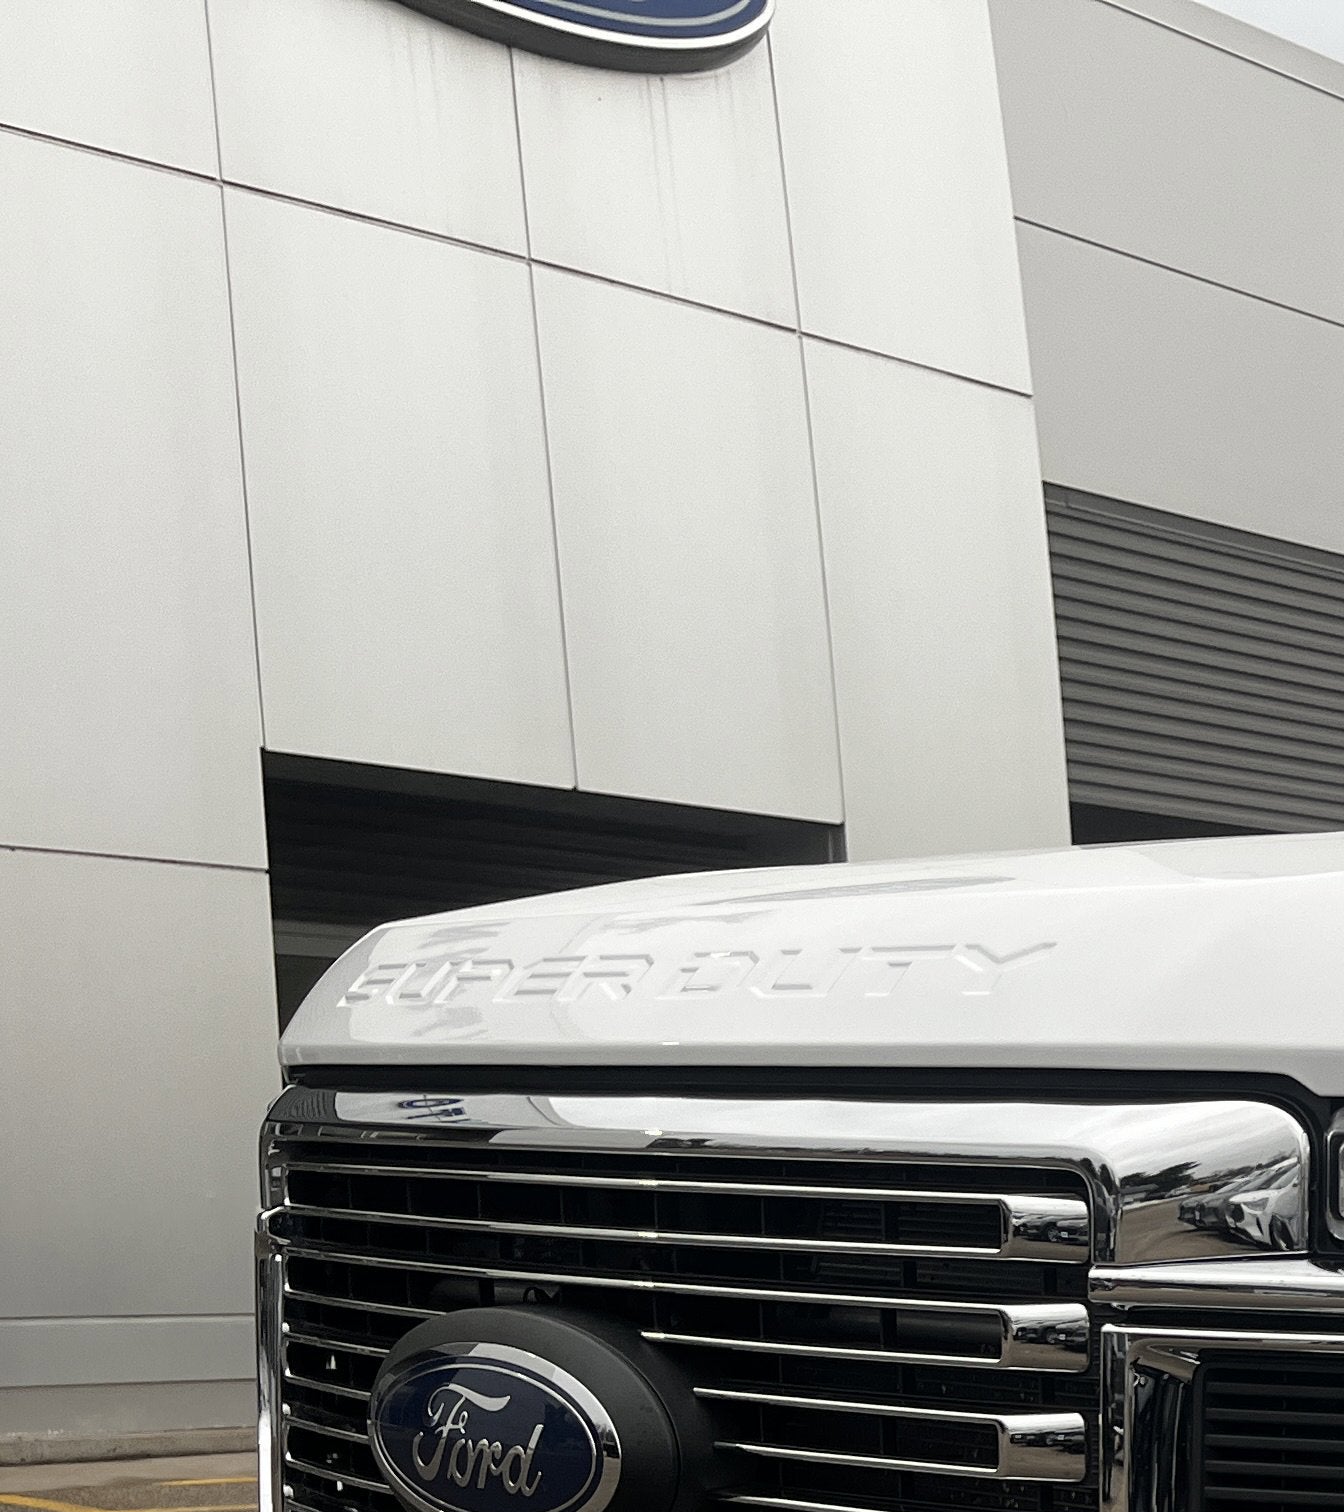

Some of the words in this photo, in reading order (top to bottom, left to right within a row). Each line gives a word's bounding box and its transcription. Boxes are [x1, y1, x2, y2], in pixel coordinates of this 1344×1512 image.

[336, 953, 655, 1007] SUPER
[656, 941, 1058, 999] DUTY
[412, 1382, 545, 1498] Ford
